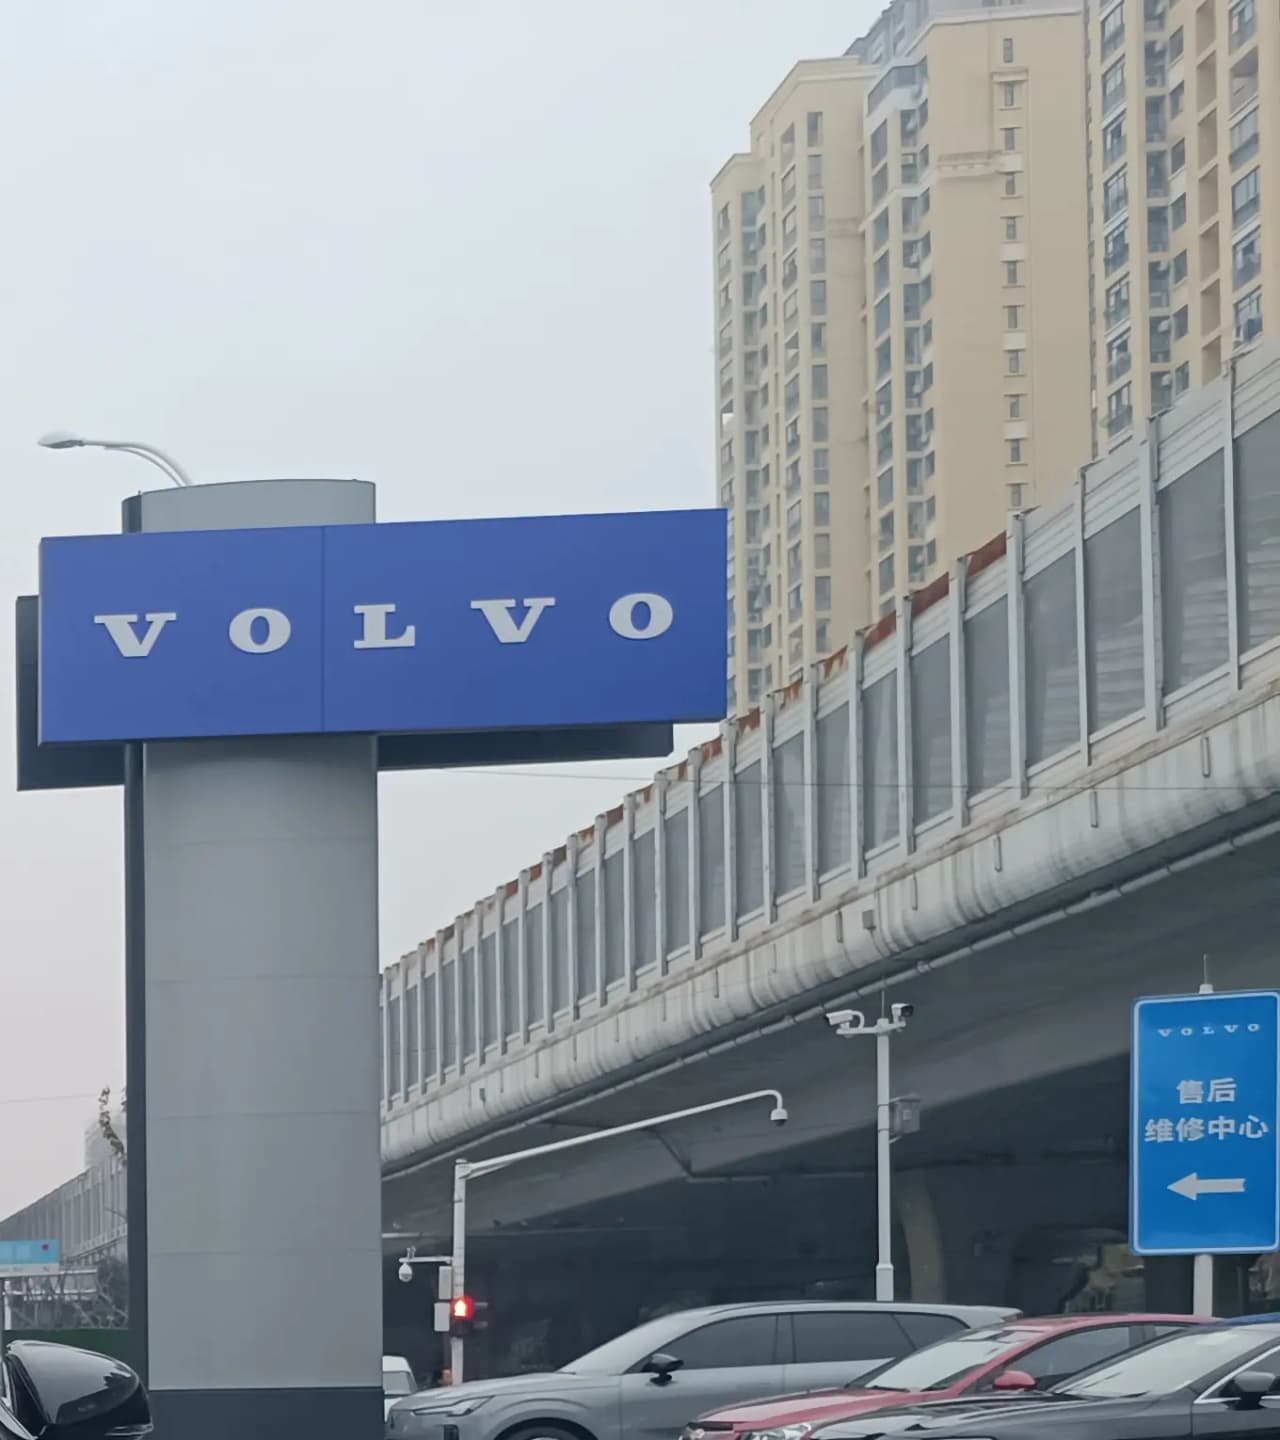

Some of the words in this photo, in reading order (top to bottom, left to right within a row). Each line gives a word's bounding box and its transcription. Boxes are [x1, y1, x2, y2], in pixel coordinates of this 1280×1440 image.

[93, 592, 674, 658] VOLVO
[1157, 1022, 1261, 1038] VOLVO
[1176, 1077, 1237, 1105] 售后
[1144, 1115, 1269, 1143] 维修中心
